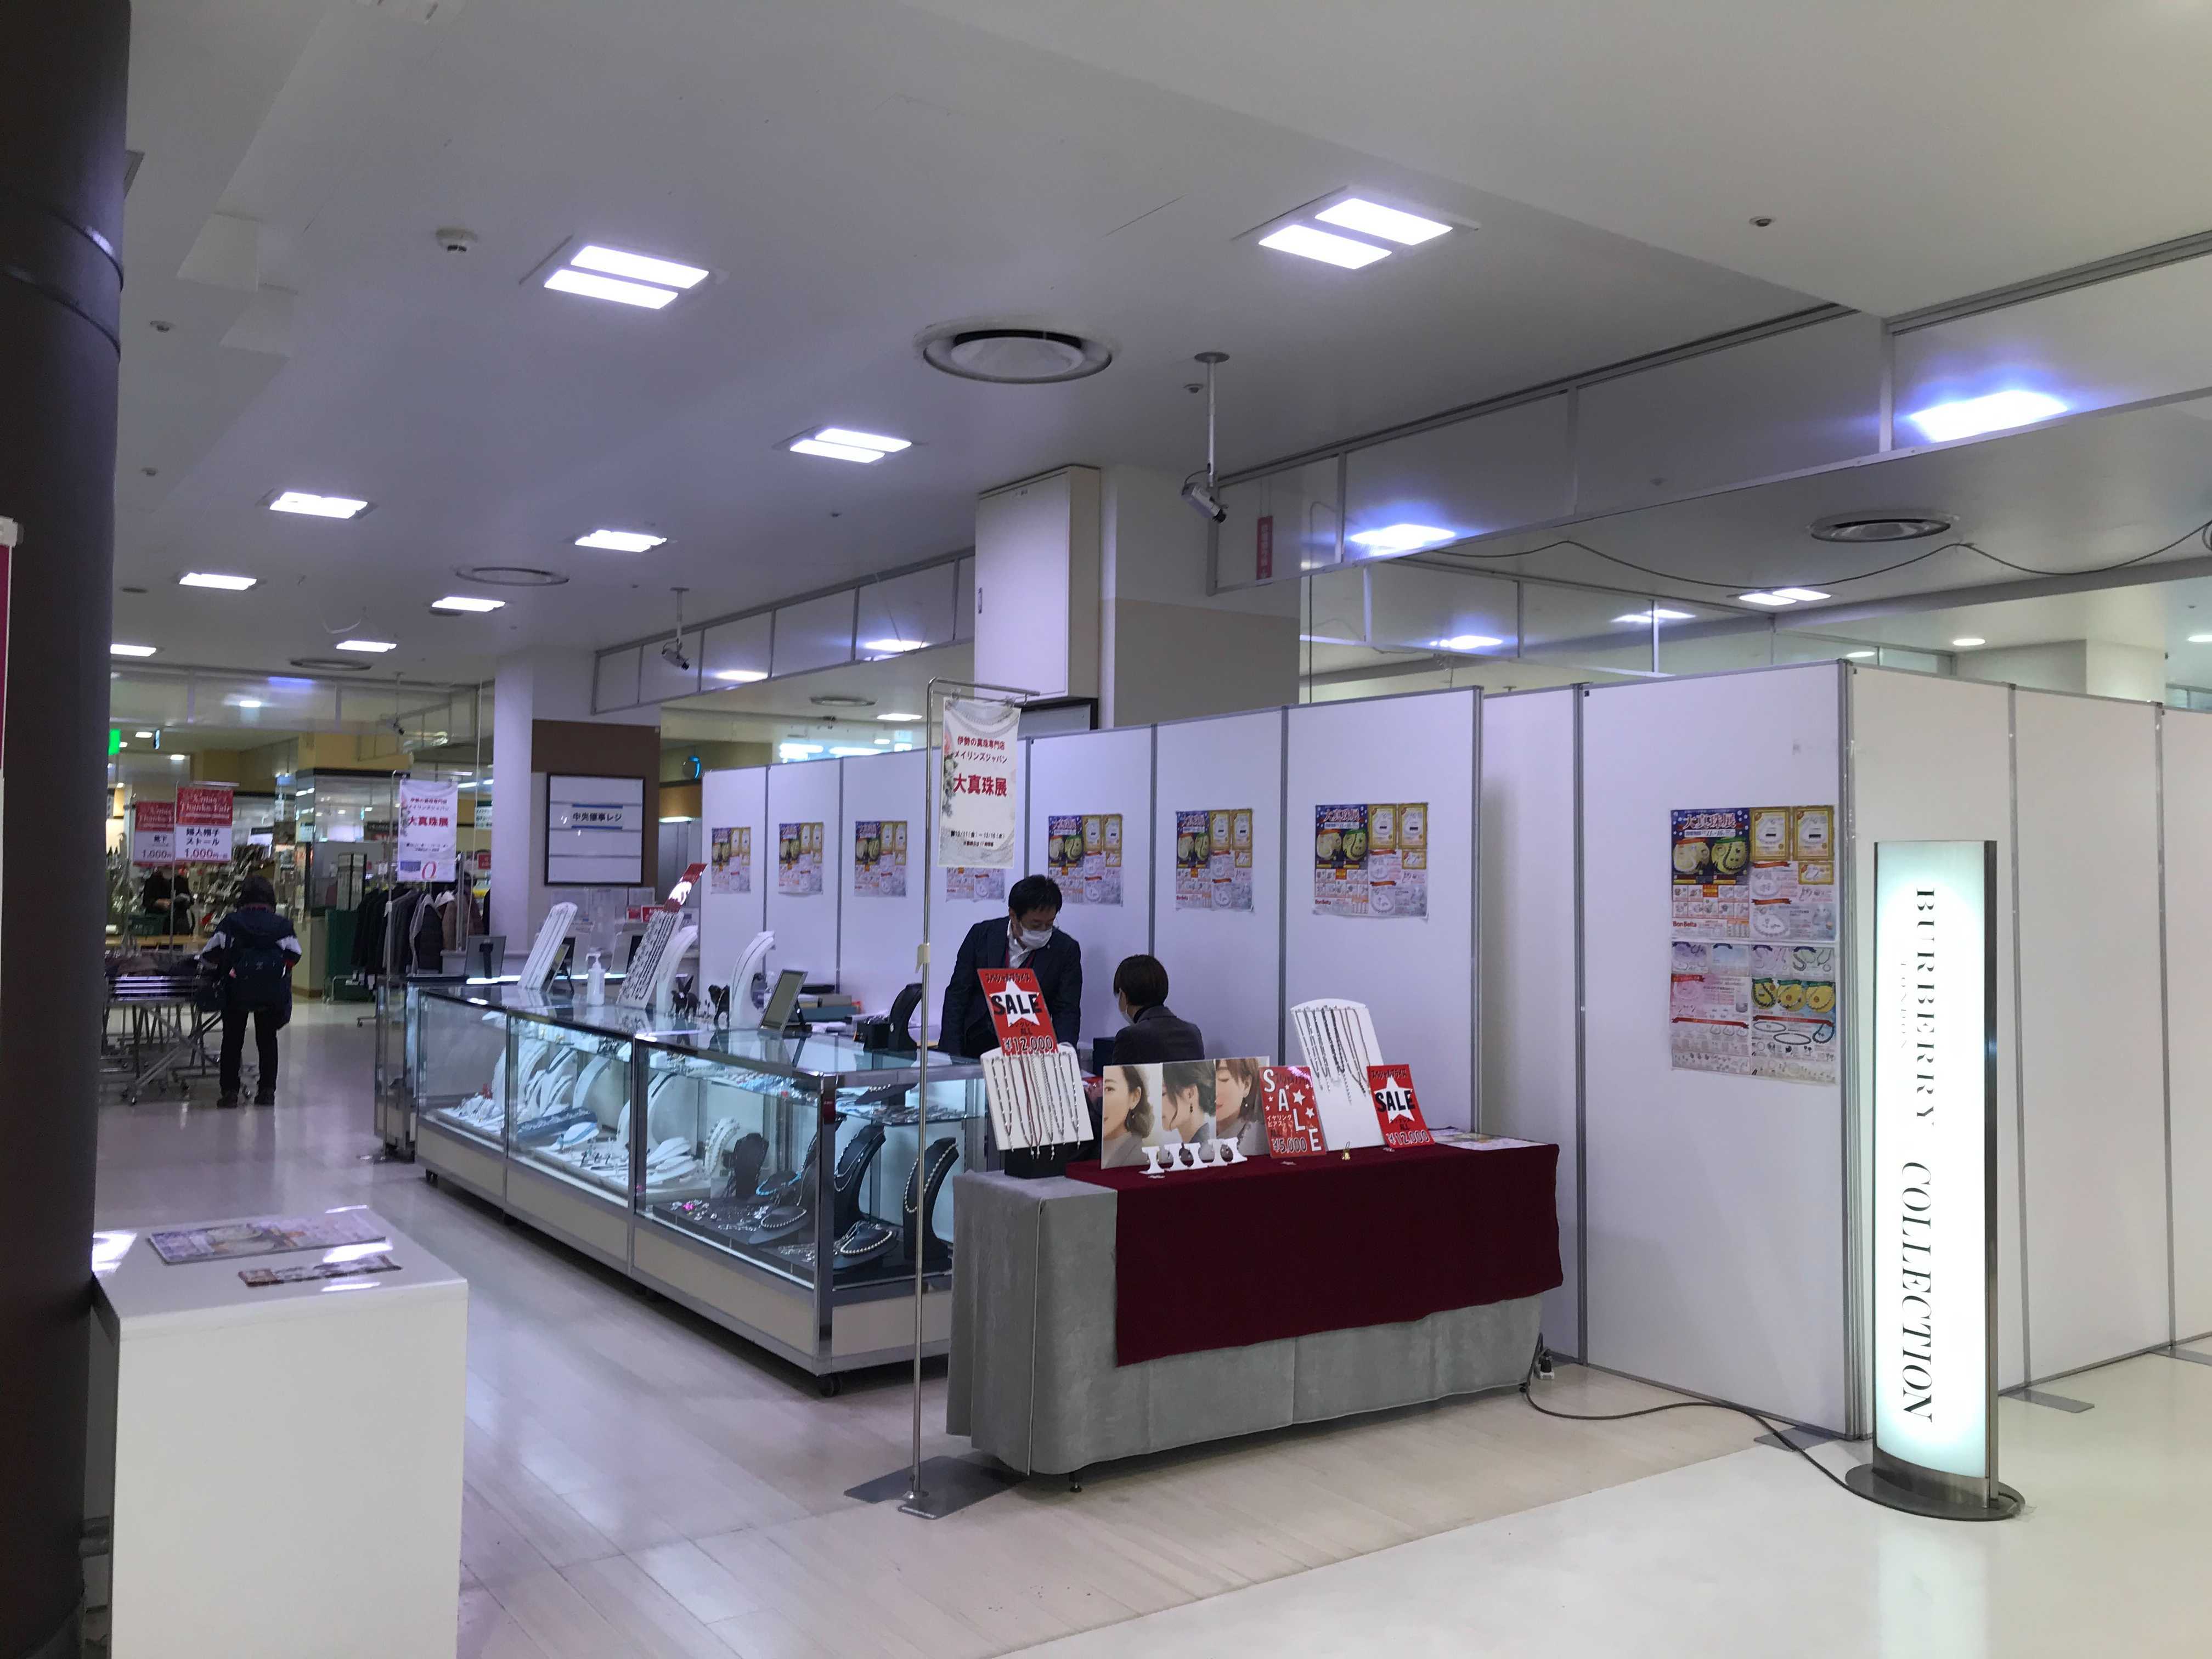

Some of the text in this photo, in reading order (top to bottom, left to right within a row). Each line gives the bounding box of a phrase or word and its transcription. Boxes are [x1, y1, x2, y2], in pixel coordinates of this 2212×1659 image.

[957, 736, 1006, 751] 伊勢の真珠専門店
[953, 750, 1008, 764] メイリンズジャパン
[952, 772, 1008, 797] 大真珠展
[186, 838, 219, 846] ストール
[990, 994, 1042, 1015] SALE
[1916, 887, 1935, 1127] BURBERRY
[1002, 1035, 1054, 1052] ¥12,000
[1374, 1090, 1416, 1113] SALE
[1271, 1136, 1308, 1154] ¥5,000
[1386, 1129, 1430, 1146] ¥12,000
[1901, 1161, 1933, 1424] COLLECTION
